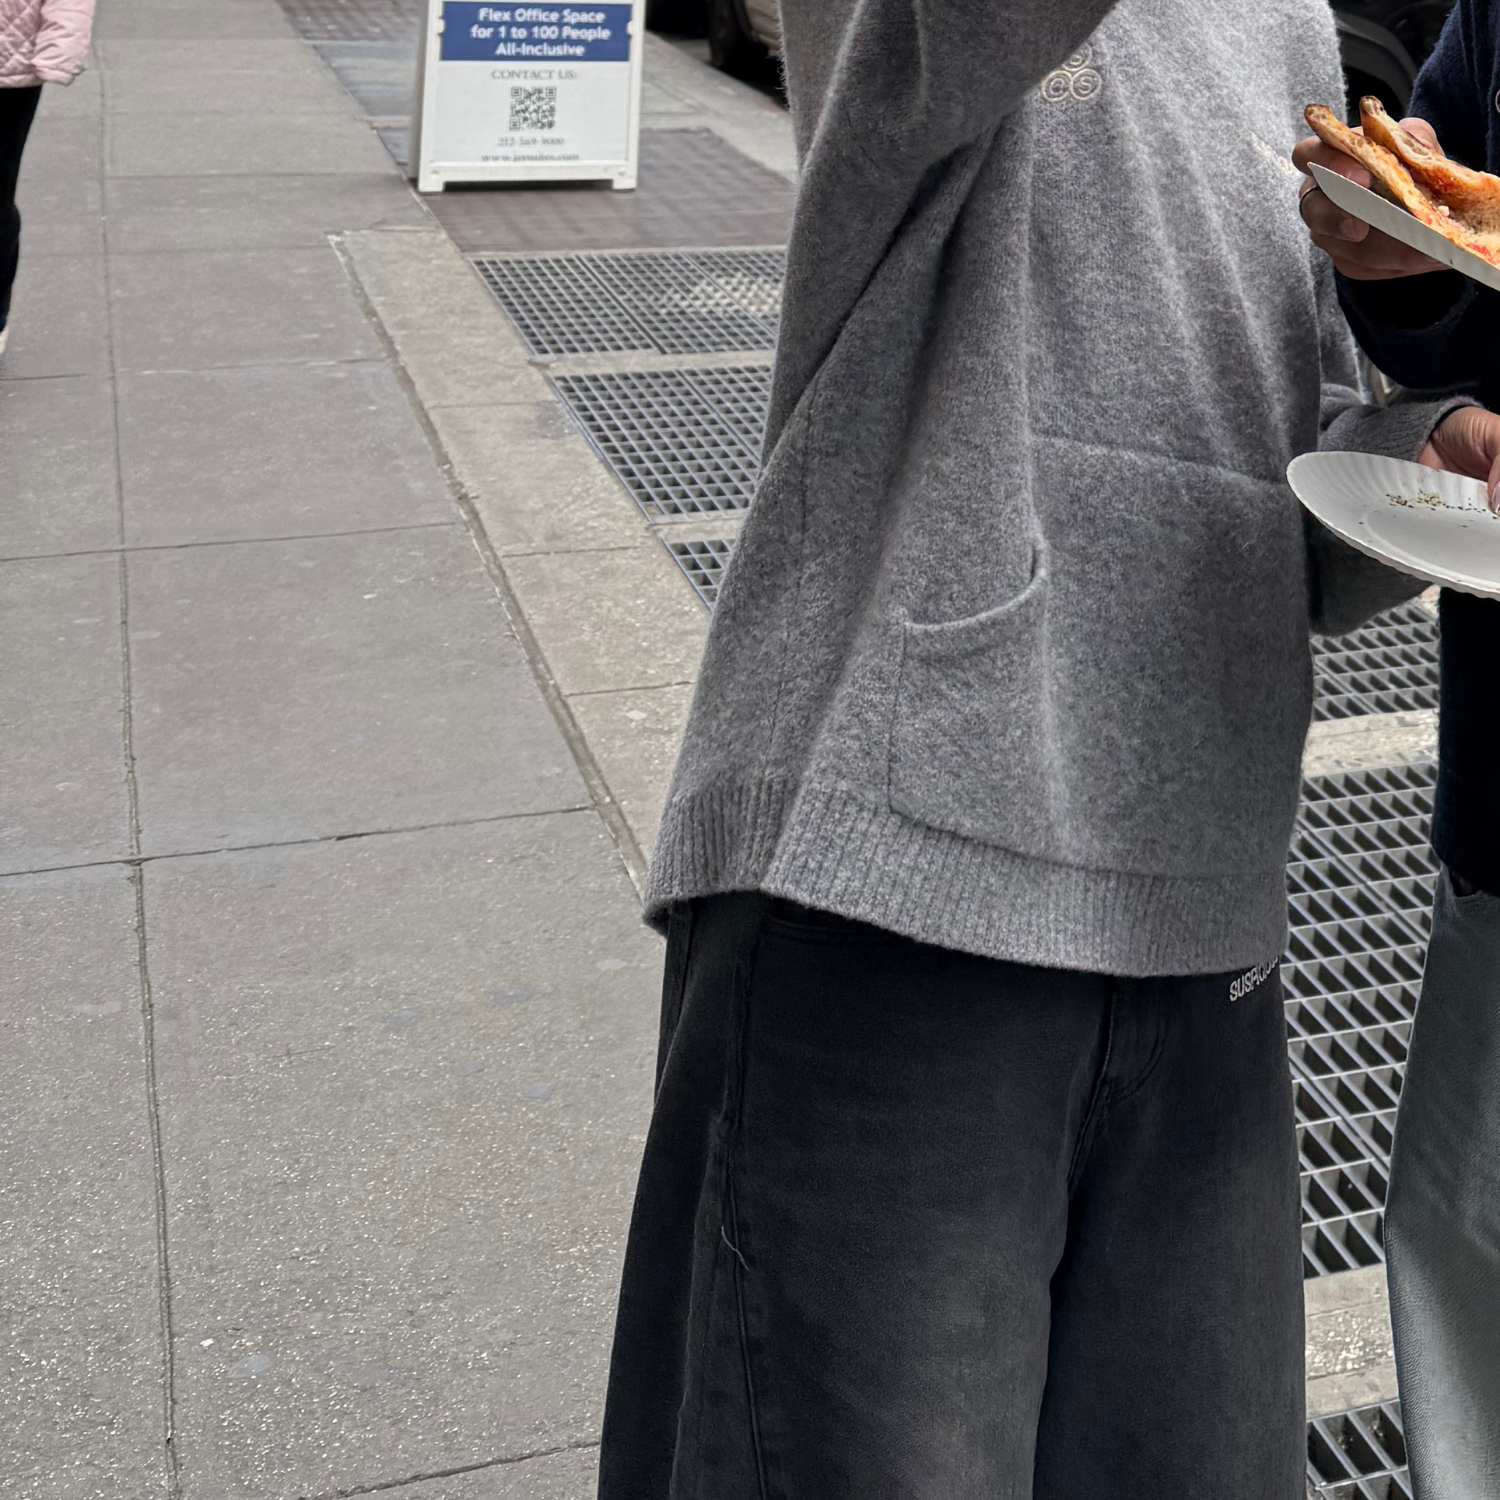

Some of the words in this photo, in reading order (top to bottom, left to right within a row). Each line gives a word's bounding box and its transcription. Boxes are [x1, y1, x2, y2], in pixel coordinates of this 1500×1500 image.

[478, 7, 511, 22] Flex
[514, 8, 558, 23] Office
[562, 9, 605, 24] Space
[470, 24, 494, 39] for
[498, 25, 505, 39] 1
[510, 26, 527, 40] to
[532, 26, 558, 40] 100
[562, 26, 612, 41] People
[494, 42, 586, 57] All-Inclusive
[491, 68, 555, 79] CONTACT
